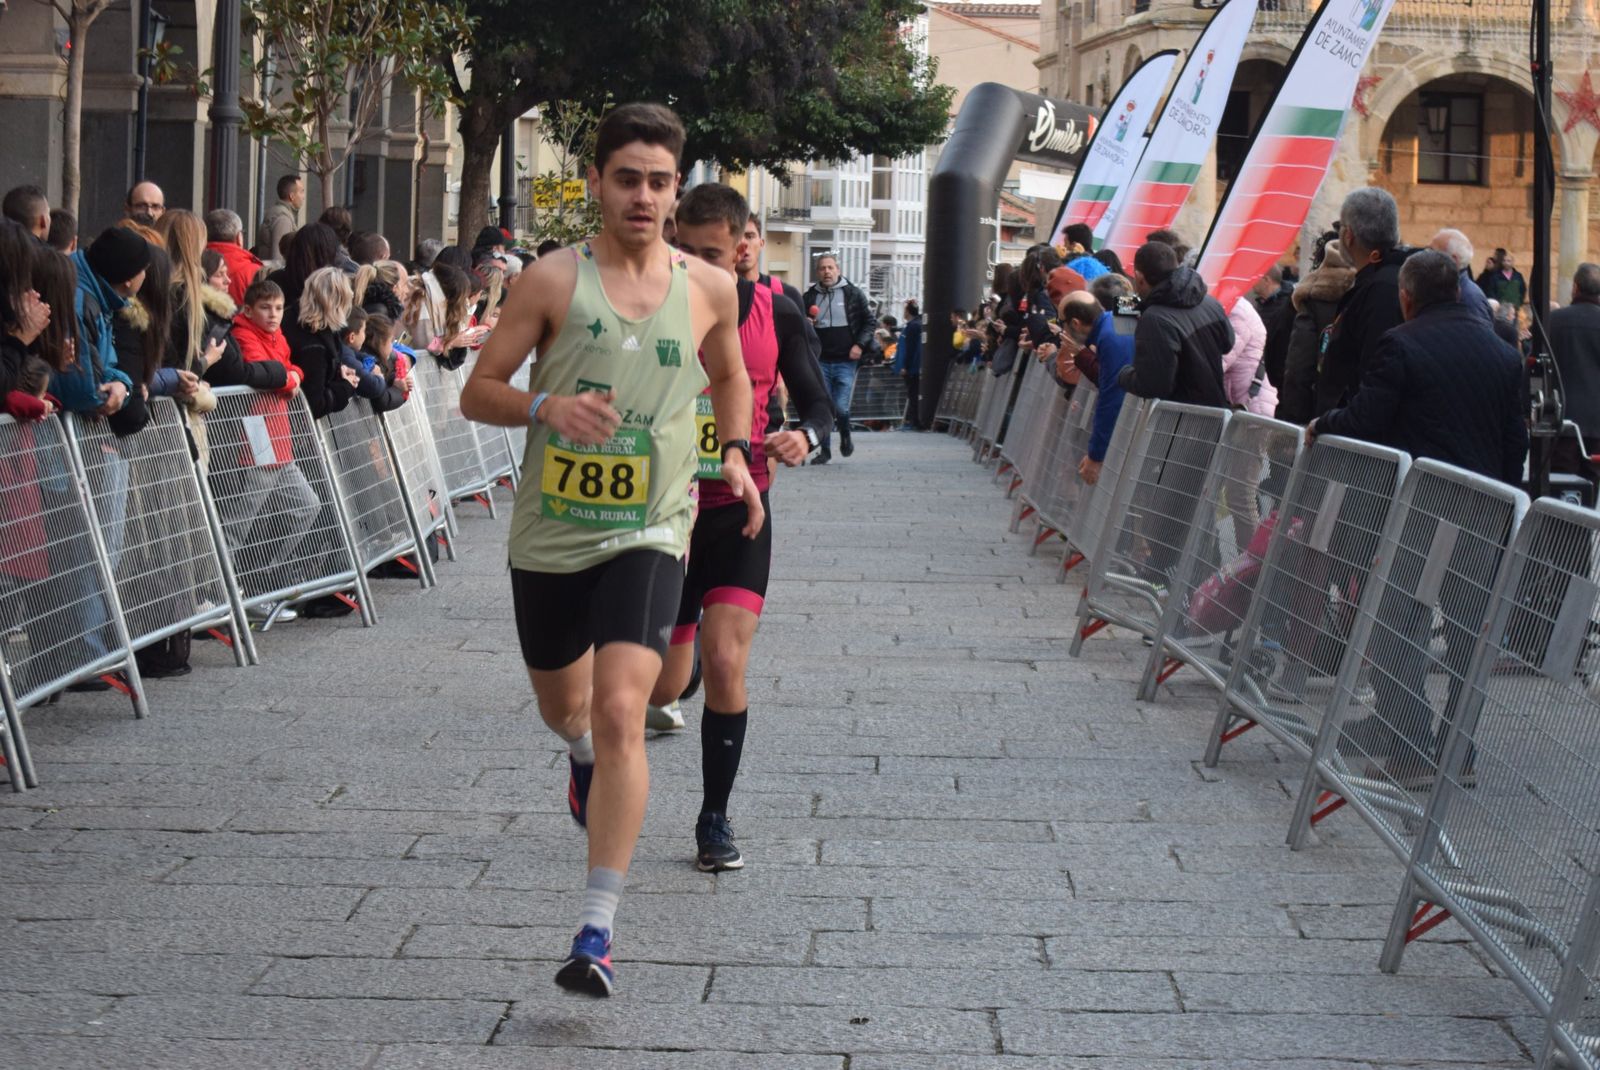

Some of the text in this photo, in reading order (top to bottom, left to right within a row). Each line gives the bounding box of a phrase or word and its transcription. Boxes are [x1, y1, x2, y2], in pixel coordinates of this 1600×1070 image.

[1315, 31, 1332, 50] DE
[601, 444, 637, 455] RURAL
[553, 455, 635, 500] 788
[569, 506, 641, 521] CAJA RURAL
